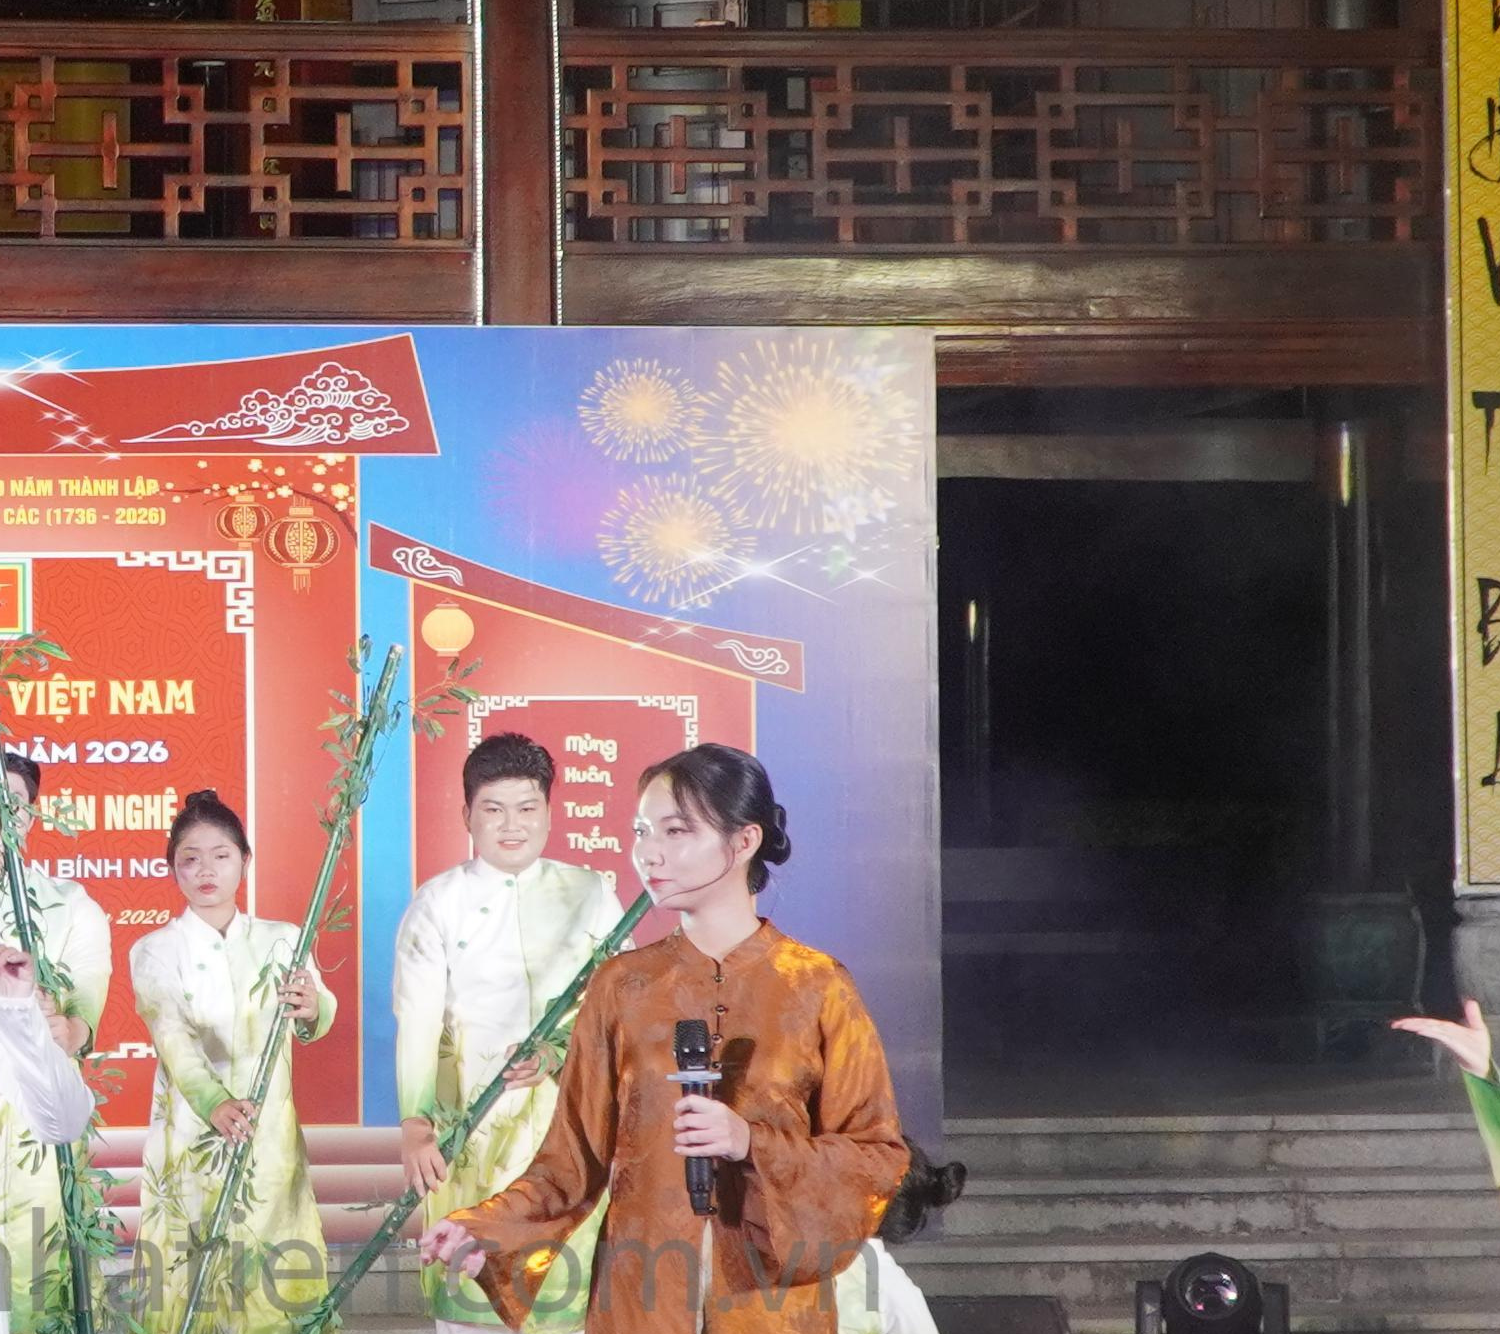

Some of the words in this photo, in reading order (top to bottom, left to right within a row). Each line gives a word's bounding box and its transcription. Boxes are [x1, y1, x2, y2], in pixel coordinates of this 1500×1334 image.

[10, 476, 53, 497] NĂM
[58, 475, 119, 497] THÀNH
[124, 475, 160, 500] LẬP
[3, 504, 40, 525] CÁC
[46, 507, 97, 526] (1736
[115, 507, 167, 526] 2026)
[7, 673, 96, 724] VIỆT
[108, 680, 196, 715] NAM
[4, 737, 78, 764] NĂM
[85, 740, 169, 764] 2026
[40, 788, 96, 832] VĂN
[104, 787, 178, 838] NGHỆ
[564, 801, 604, 818] Tươi
[567, 825, 622, 853] Thắm
[57, 854, 122, 879] BÍNH
[116, 909, 170, 925] 2026
